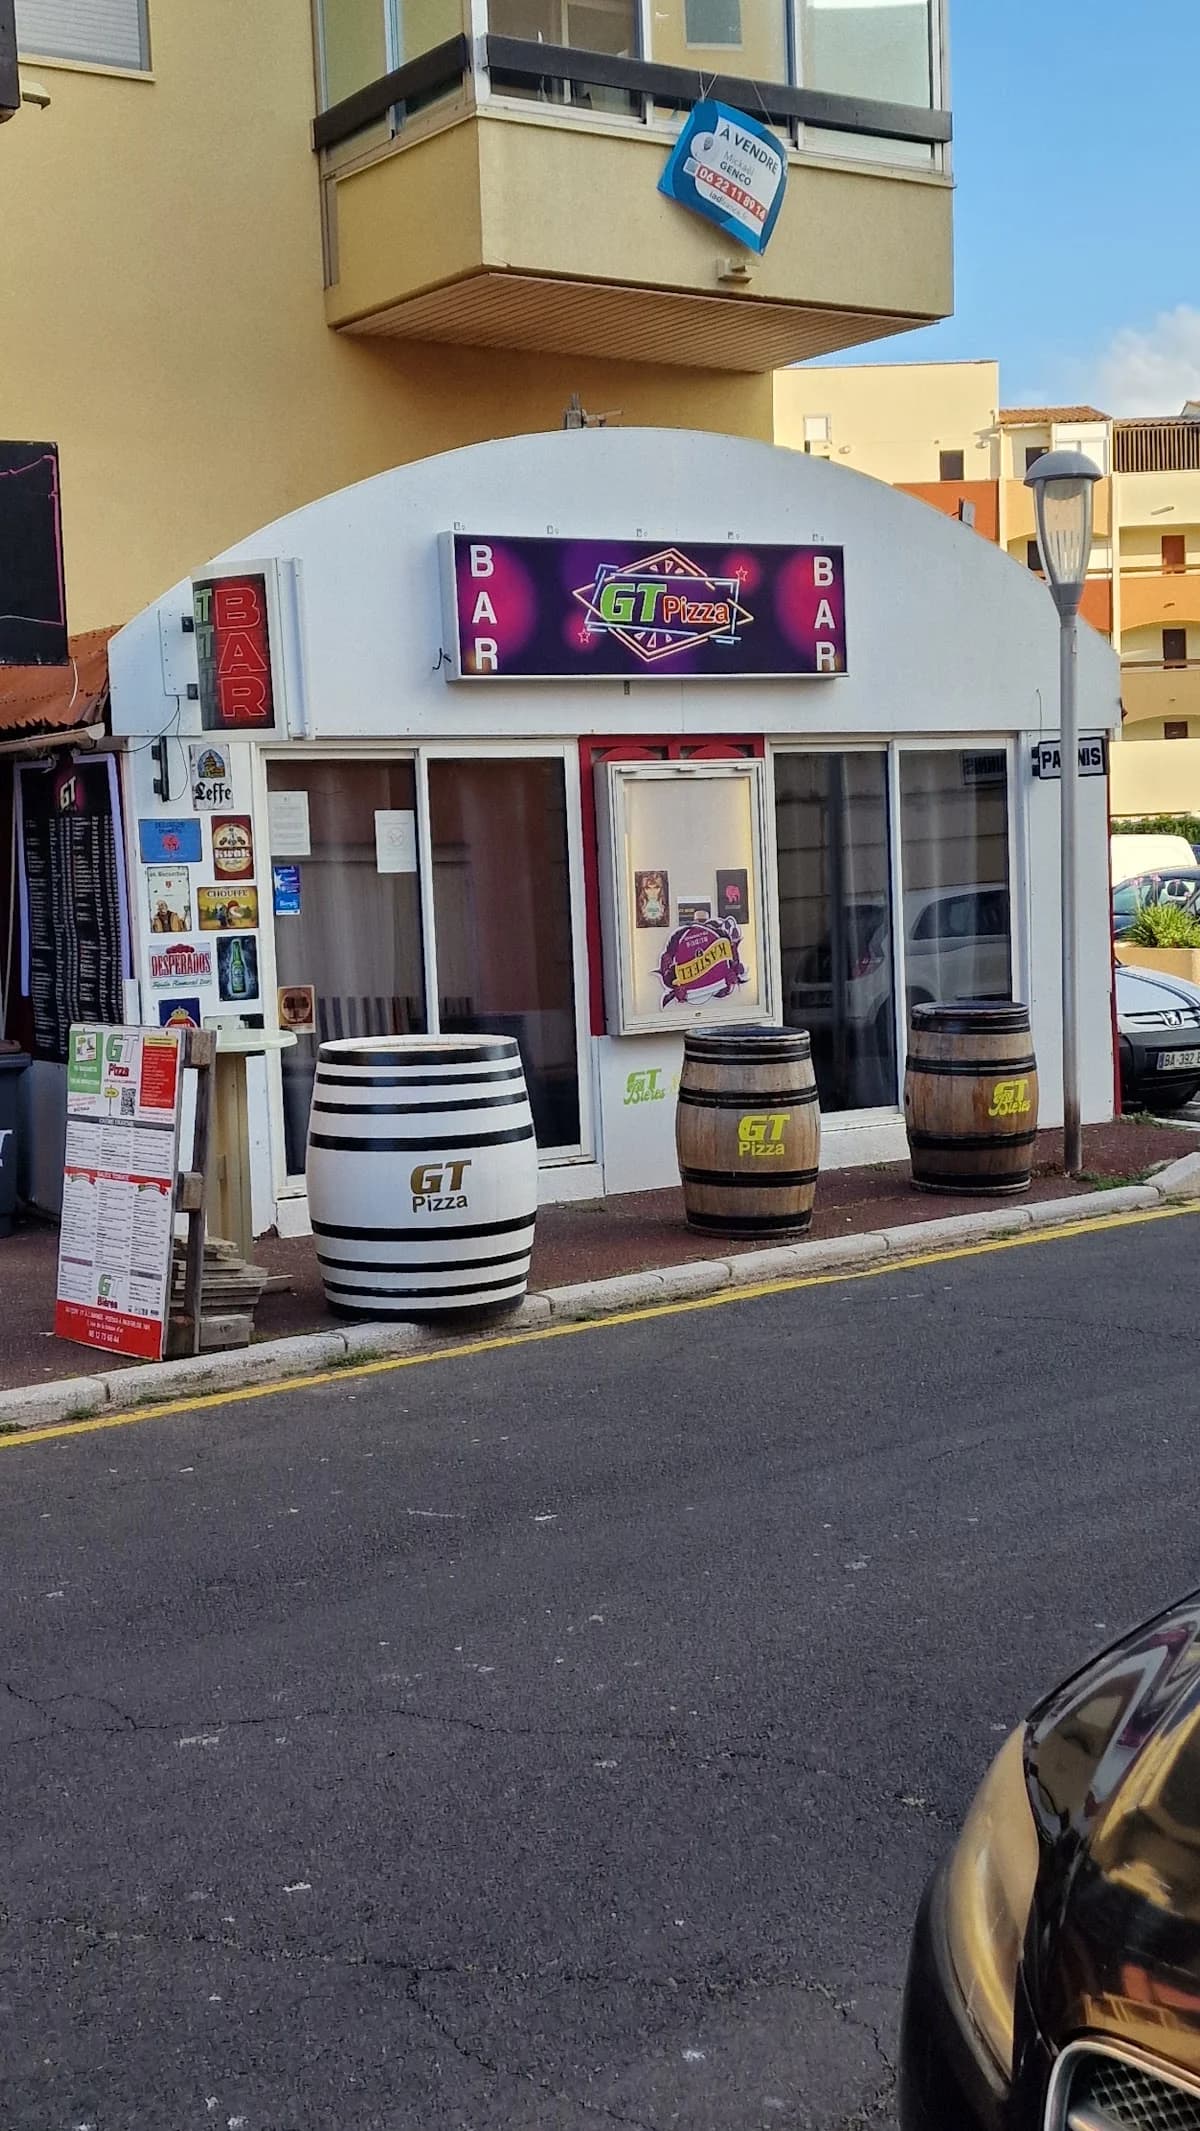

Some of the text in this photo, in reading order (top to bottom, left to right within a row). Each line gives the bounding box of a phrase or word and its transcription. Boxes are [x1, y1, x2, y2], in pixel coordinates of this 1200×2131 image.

[735, 132, 779, 177] VENDRE
[699, 166, 714, 181] 06
[714, 176, 730, 193] 22
[730, 186, 743, 203] 11
[742, 195, 756, 209] 89
[720, 161, 751, 186] GENCO
[469, 544, 499, 671] BAR
[599, 582, 729, 624] GT Pizza
[812, 555, 837, 672] BAR
[215, 587, 268, 717] BAR
[1041, 747, 1101, 770] PANIS
[60, 775, 77, 810] GT
[194, 781, 232, 804] Leffe
[151, 952, 212, 977] DESPERADOS
[677, 941, 729, 981] KASTEEL
[106, 1033, 140, 1064] GT
[994, 1079, 1029, 1103] GT
[738, 1113, 791, 1142] GT
[739, 1141, 785, 1156] Pizza
[410, 1159, 472, 1195] GT
[412, 1195, 468, 1214] Pizza
